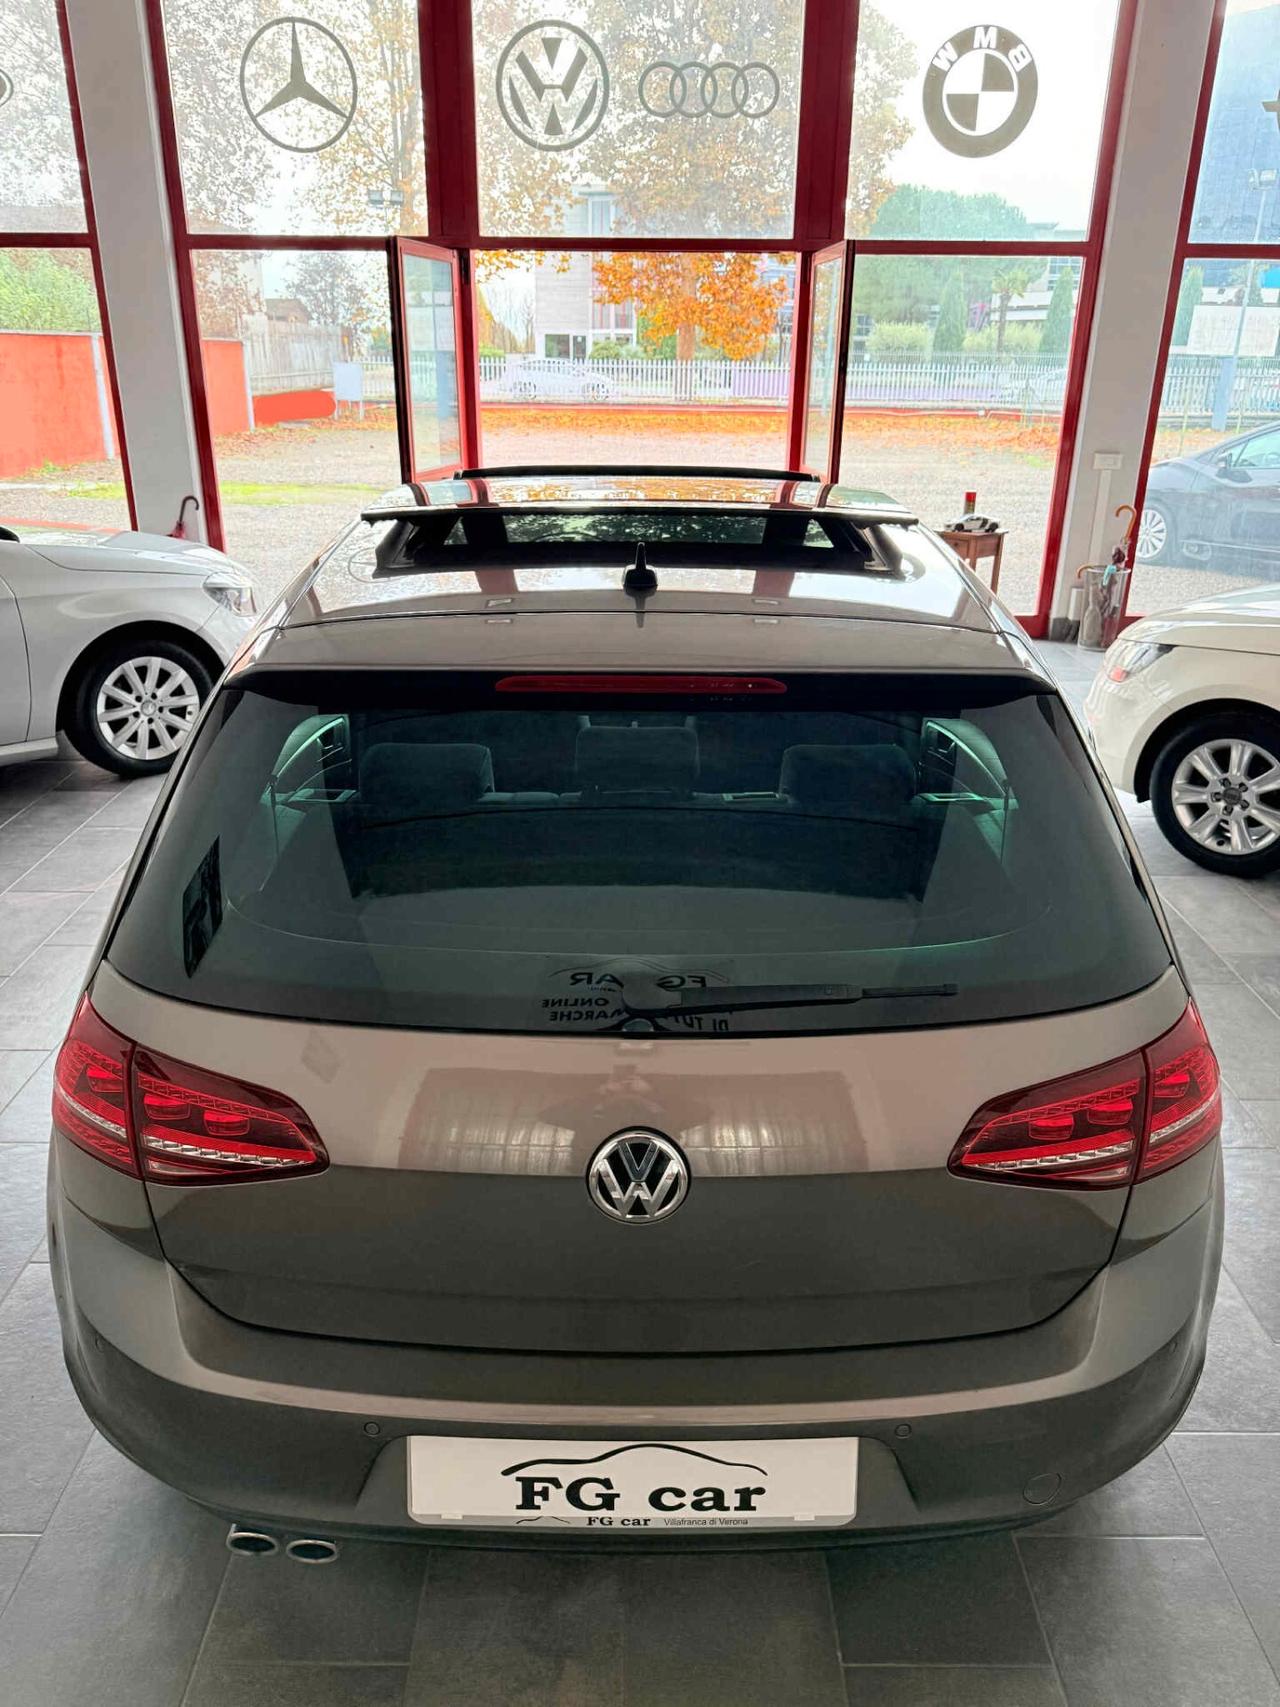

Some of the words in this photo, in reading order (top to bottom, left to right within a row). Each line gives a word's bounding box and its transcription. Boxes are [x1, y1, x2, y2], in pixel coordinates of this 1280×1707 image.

[515, 1477, 621, 1512] FG
[648, 1486, 767, 1512] car
[586, 1516, 614, 1526] FG
[621, 1518, 652, 1527] car
[664, 1517, 707, 1526] Villafranca
[709, 1517, 718, 1526] di
[719, 1518, 749, 1526] Verona
